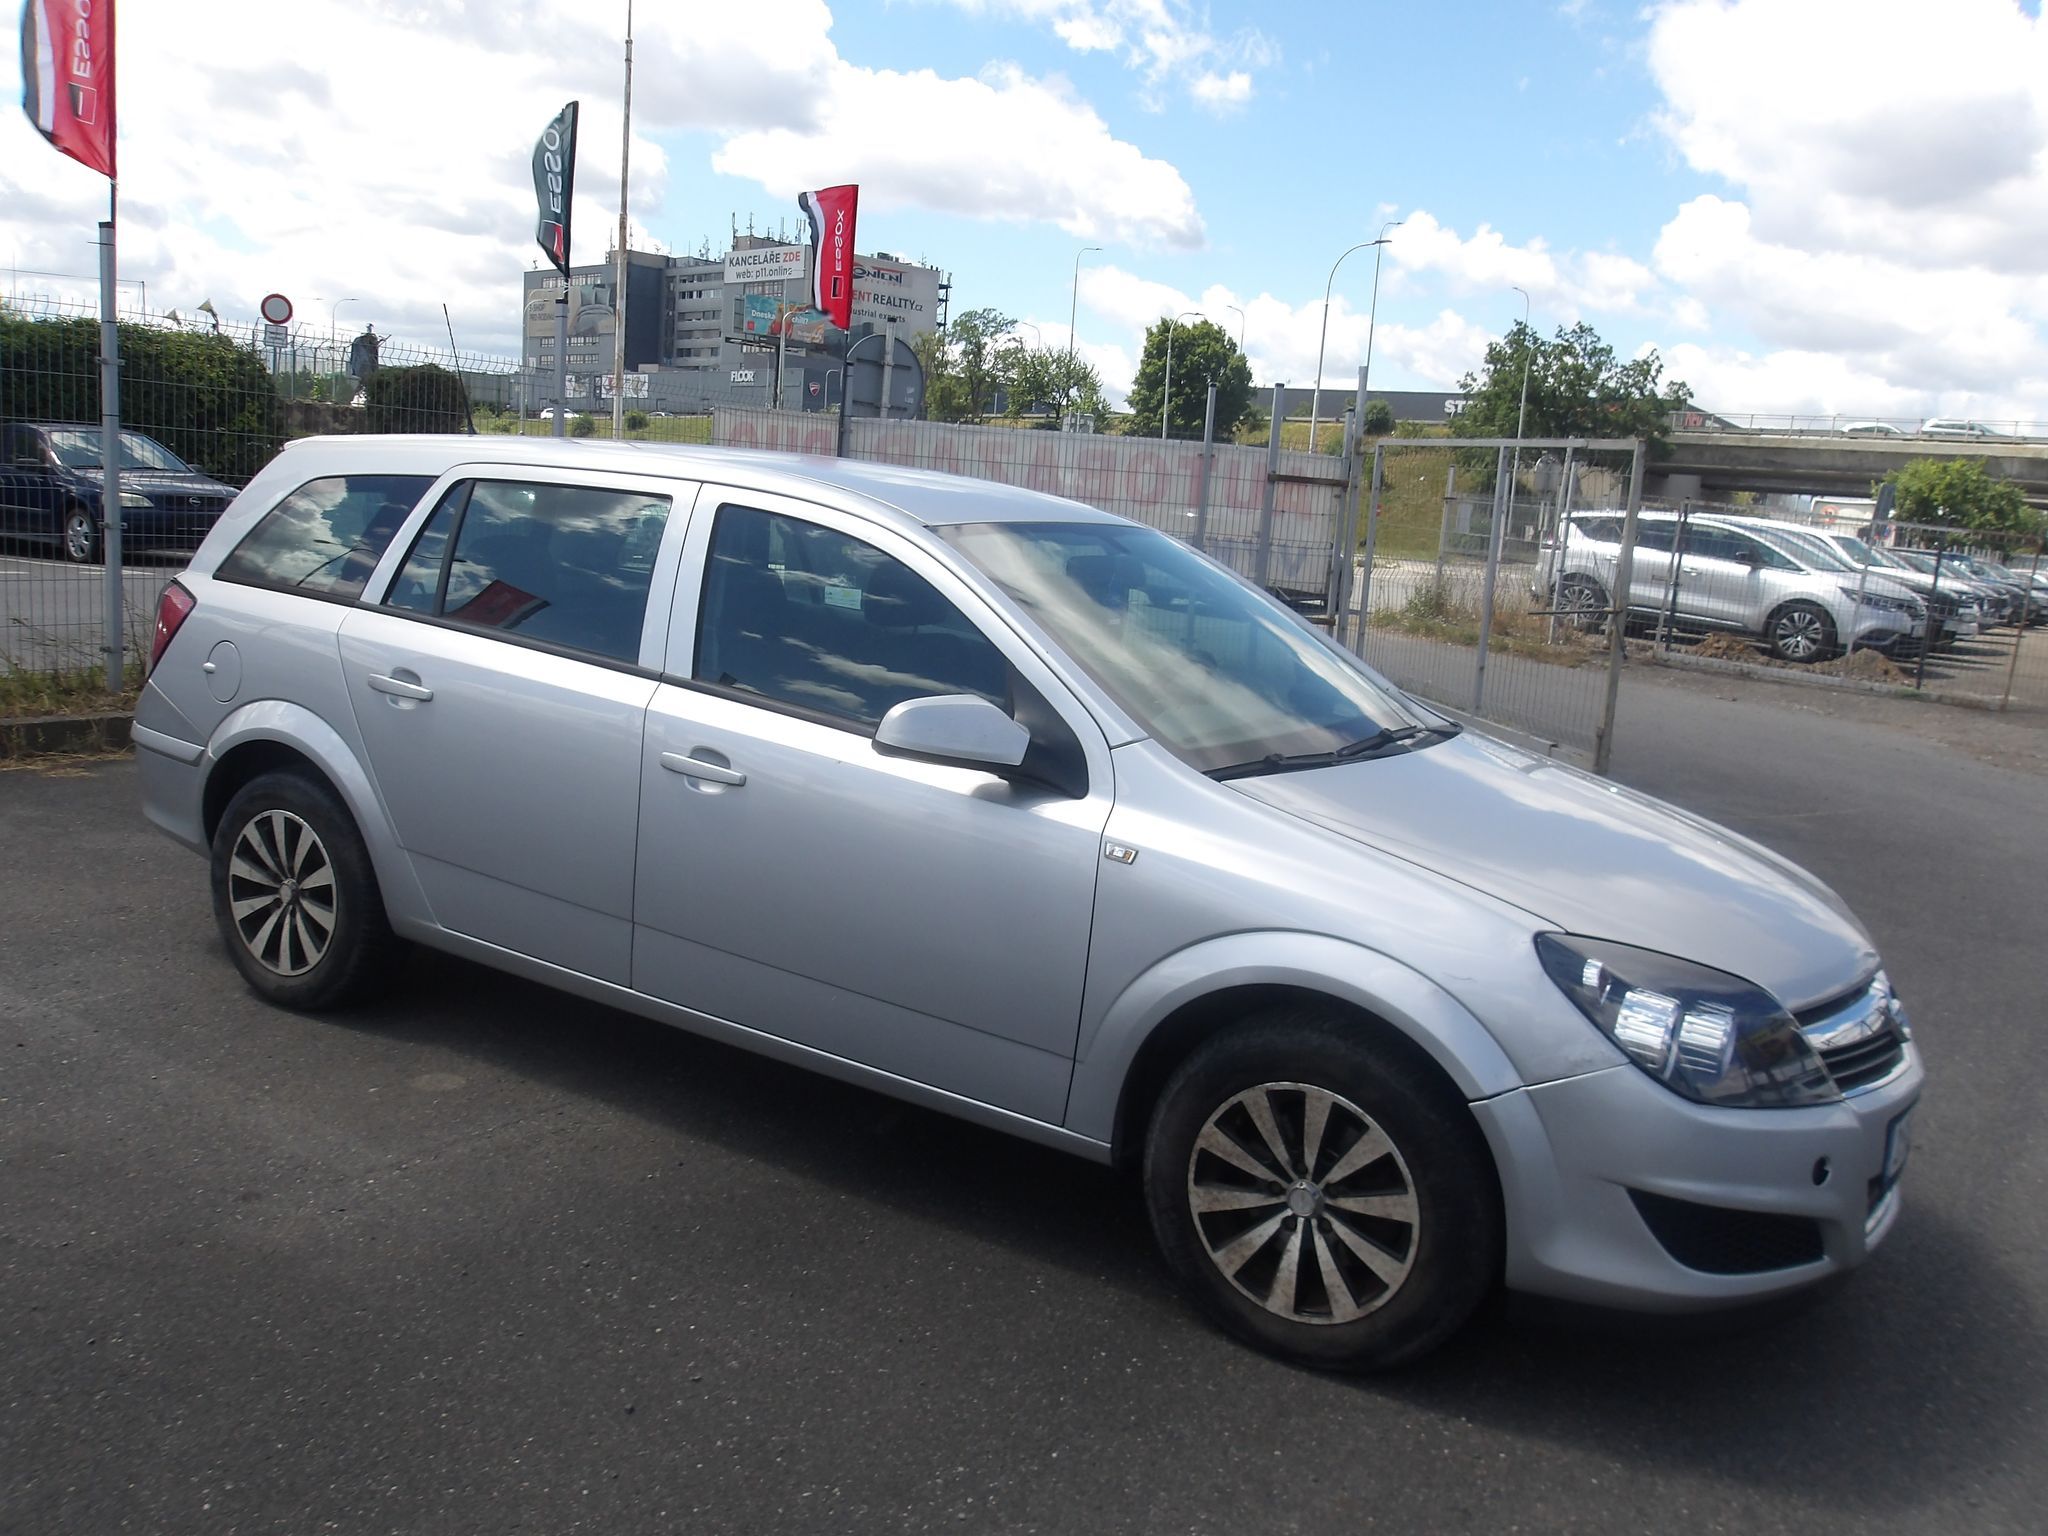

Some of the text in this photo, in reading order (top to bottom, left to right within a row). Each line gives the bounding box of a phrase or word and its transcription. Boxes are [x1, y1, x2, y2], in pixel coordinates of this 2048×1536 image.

[729, 251, 800, 267] KANCELÁŘE ZDE
[736, 269, 754, 279] web:
[853, 267, 903, 285] ONTENT
[853, 308, 877, 319] ustrial
[730, 370, 754, 382] FLOOR
